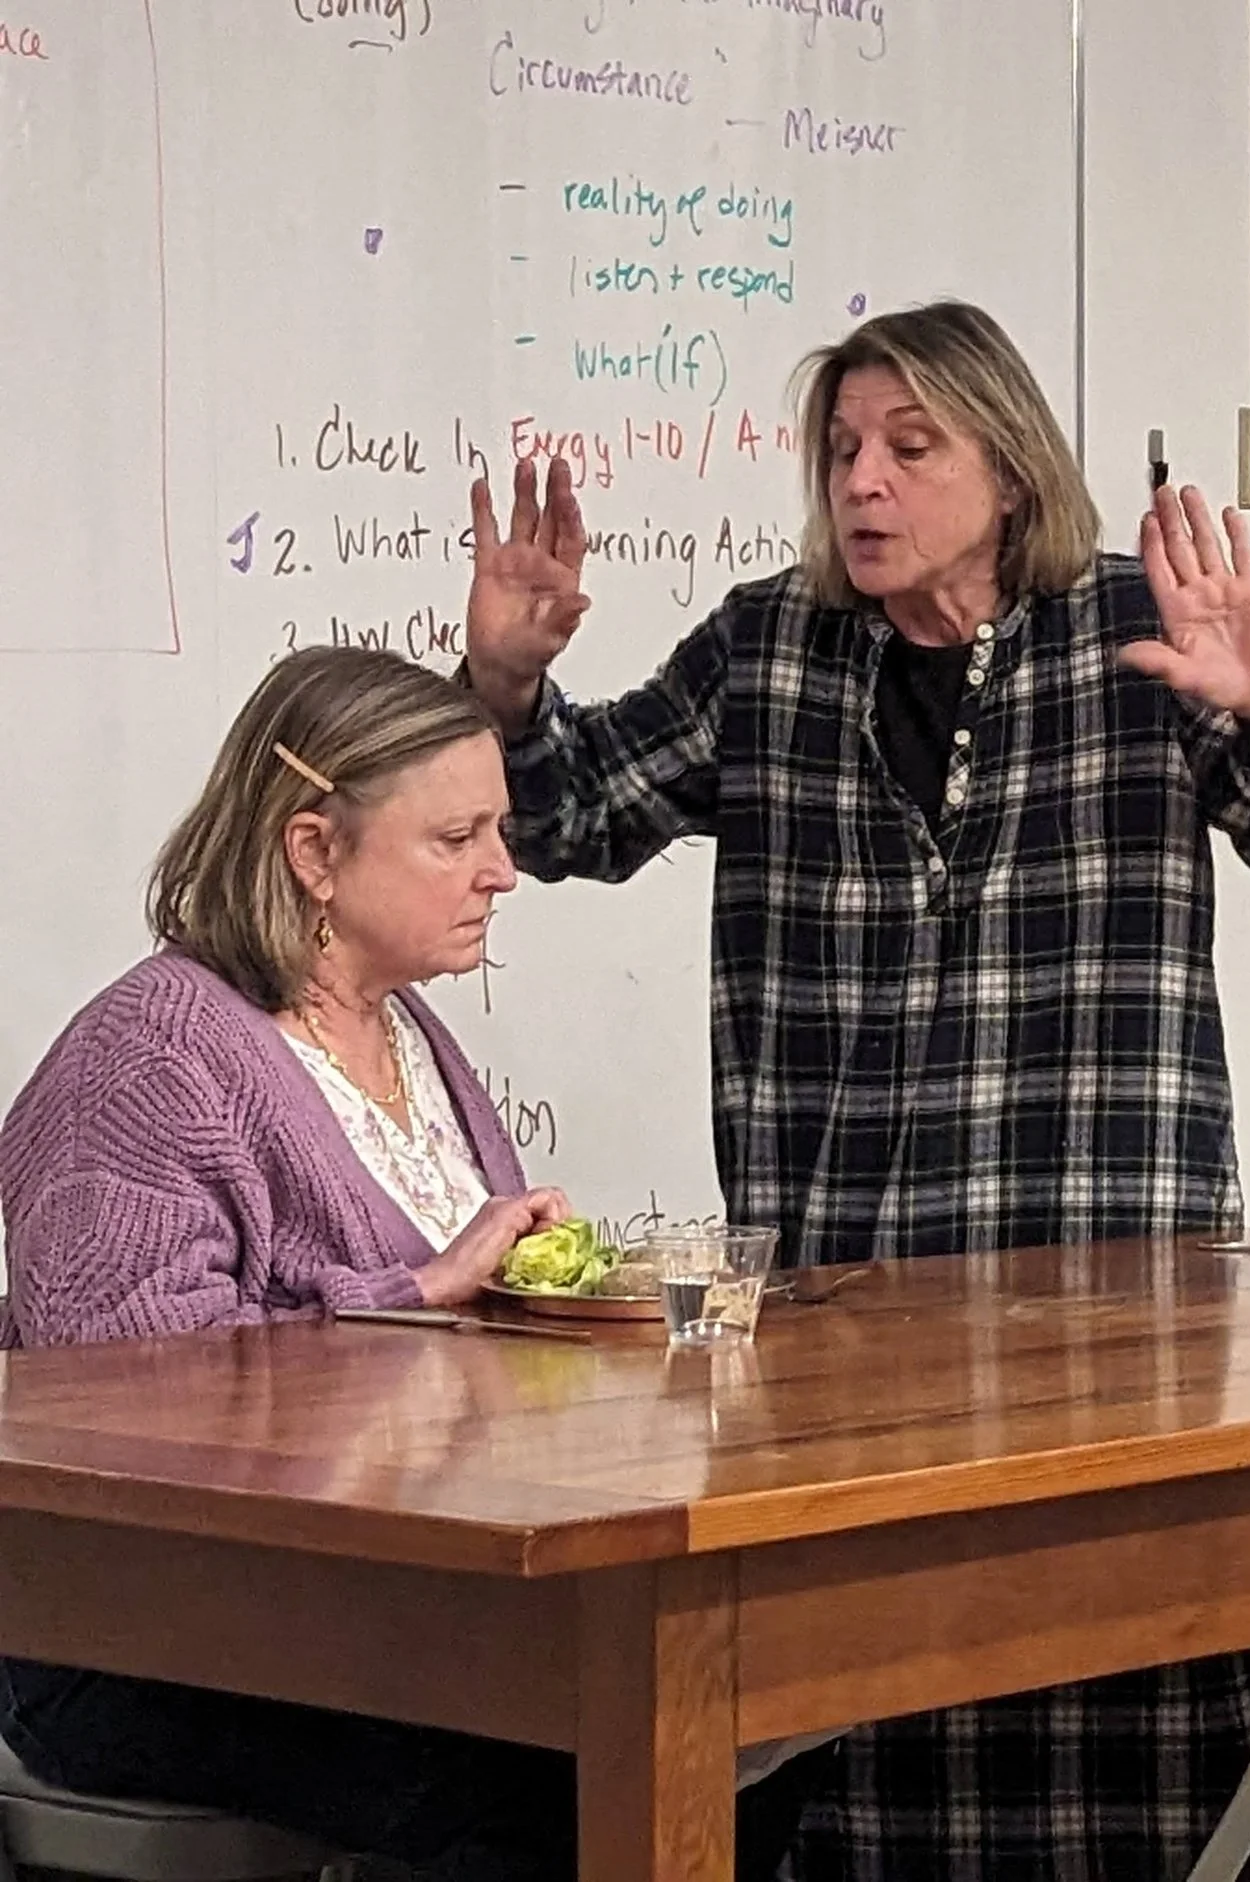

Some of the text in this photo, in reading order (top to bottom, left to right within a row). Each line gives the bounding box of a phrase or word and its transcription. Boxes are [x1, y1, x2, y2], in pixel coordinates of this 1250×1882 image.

[490, 30, 692, 105] Circumstance
[563, 174, 667, 247] reality
[717, 180, 795, 248] doing
[570, 255, 658, 298] listen
[697, 258, 794, 313] respond
[315, 402, 426, 473] Check
[456, 416, 489, 480] In
[333, 511, 431, 564] What
